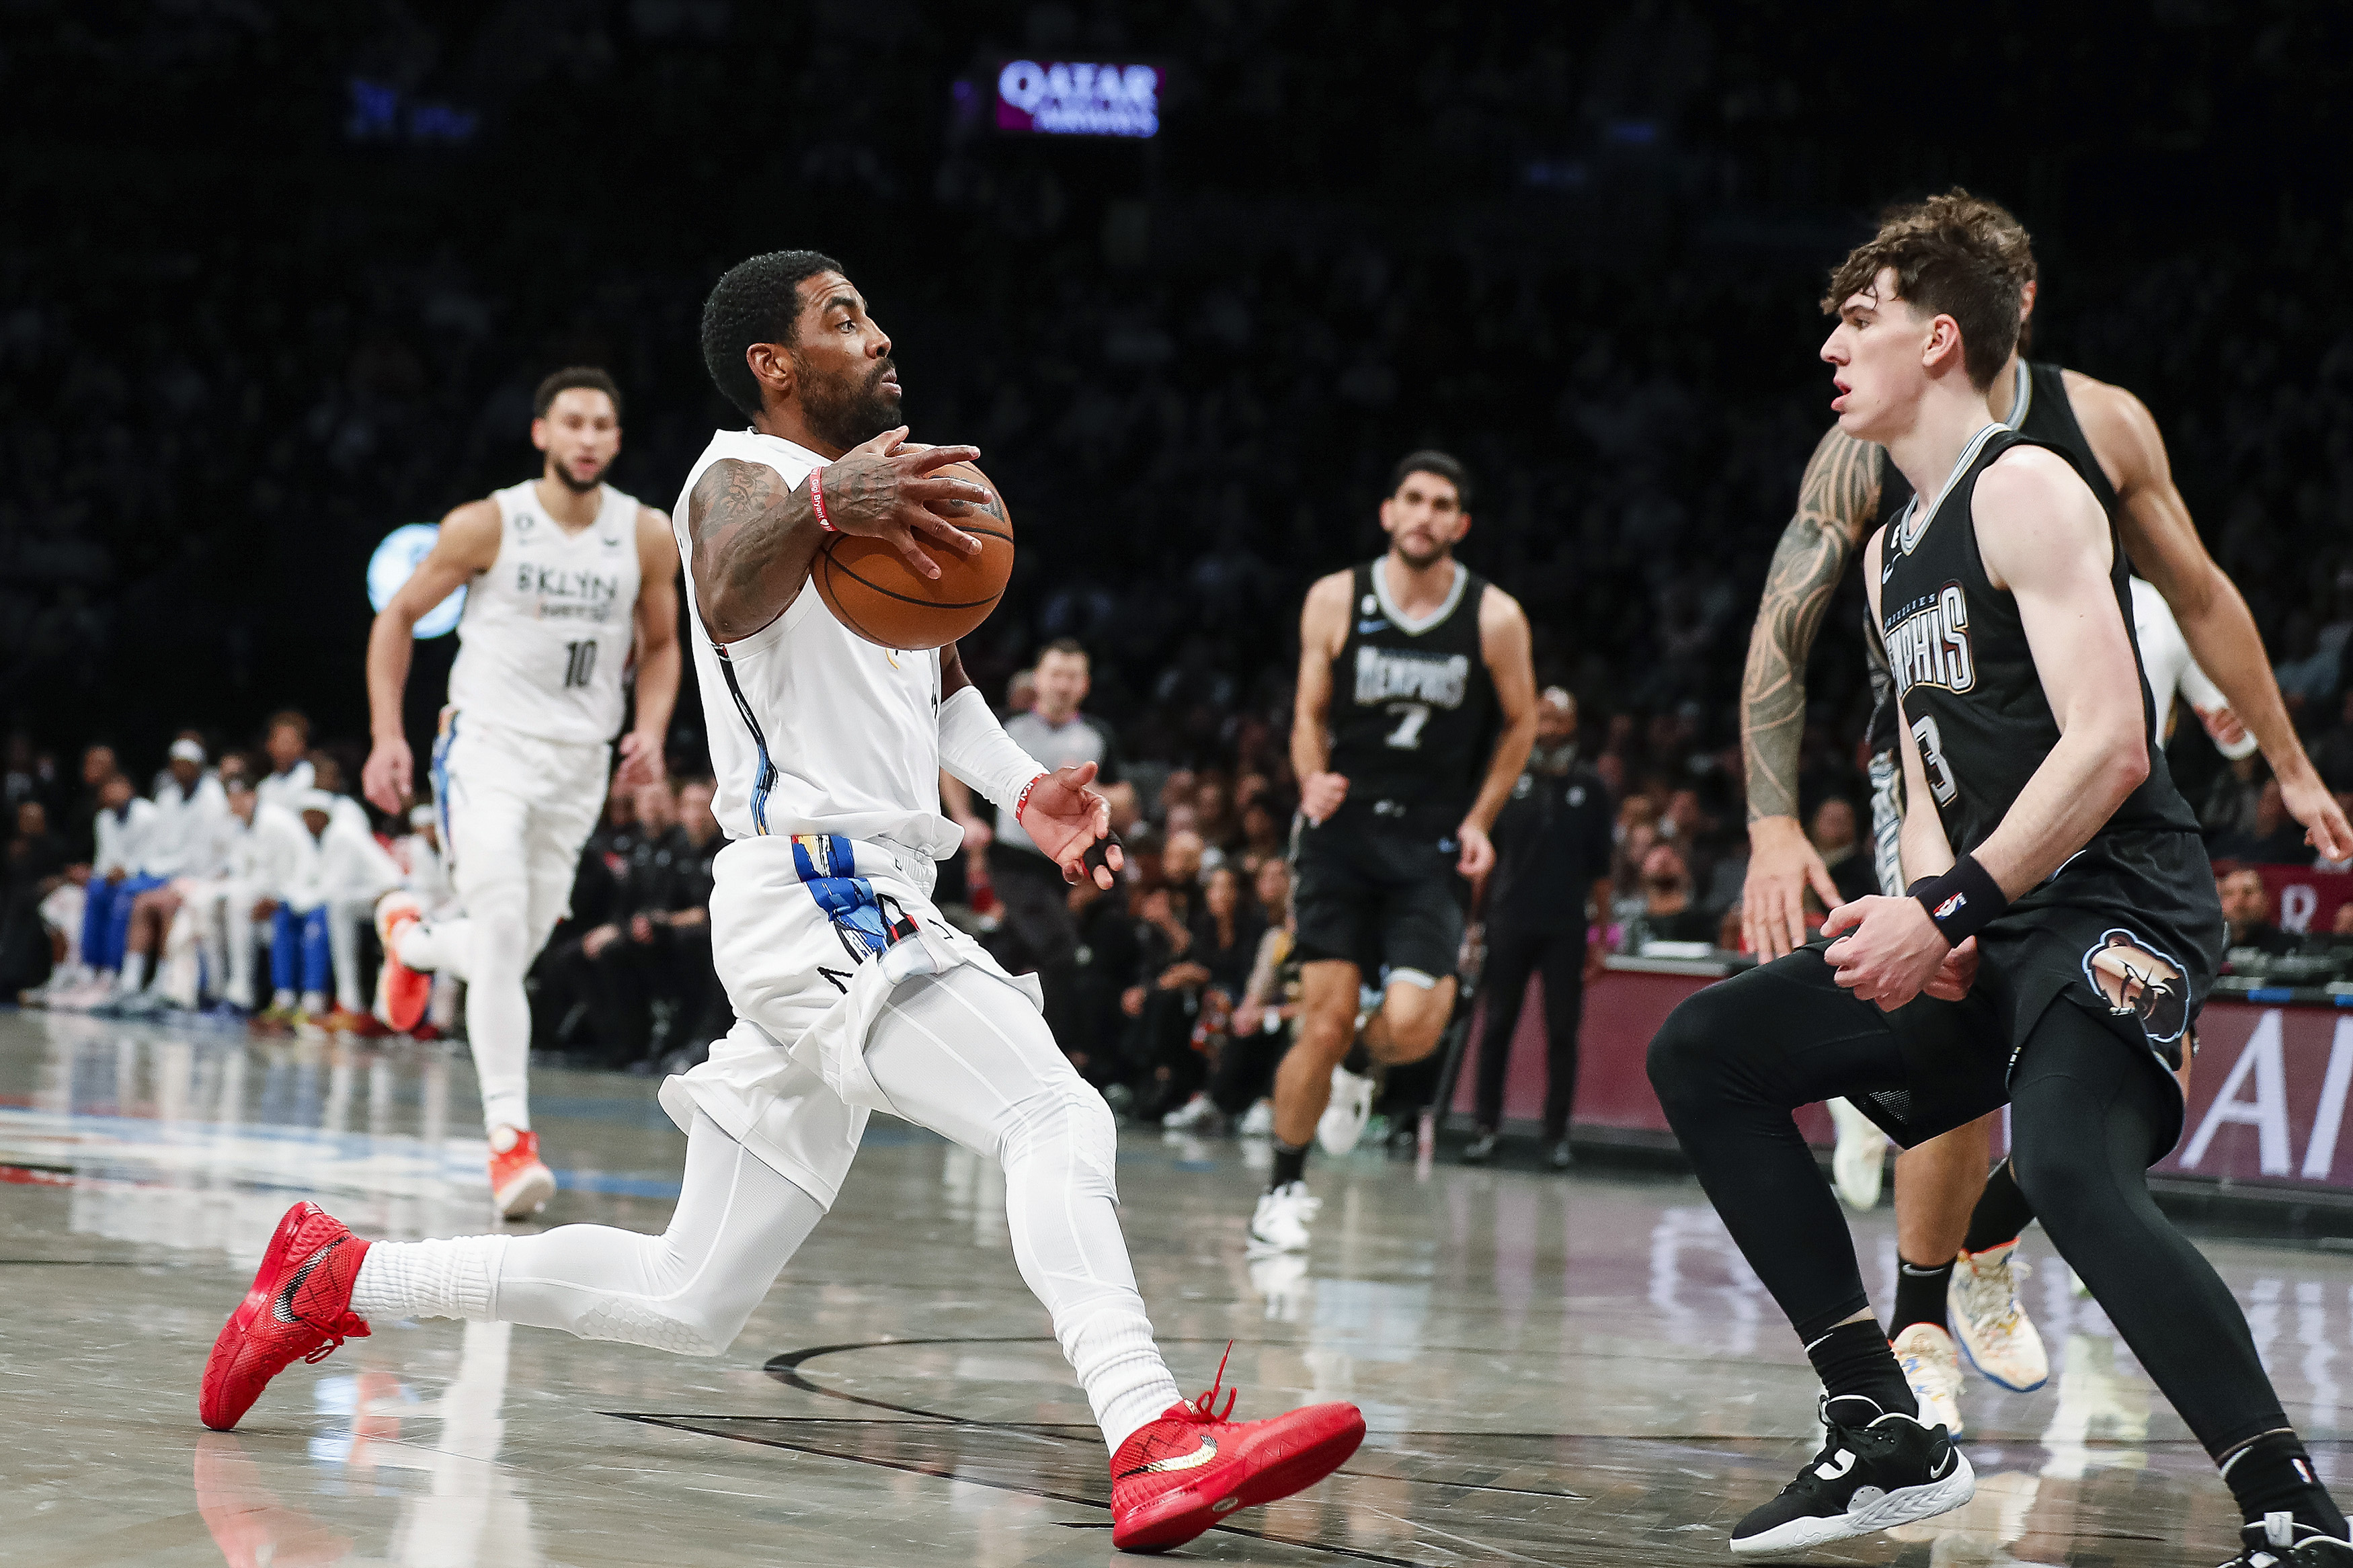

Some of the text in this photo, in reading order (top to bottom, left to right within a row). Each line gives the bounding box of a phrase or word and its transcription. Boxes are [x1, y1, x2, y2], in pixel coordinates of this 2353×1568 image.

[813, 494, 824, 519] Bryant
[517, 563, 618, 600] BKLYN
[564, 639, 597, 688] 10
[1385, 702, 1429, 749] 7
[1912, 715, 1957, 807] 3
